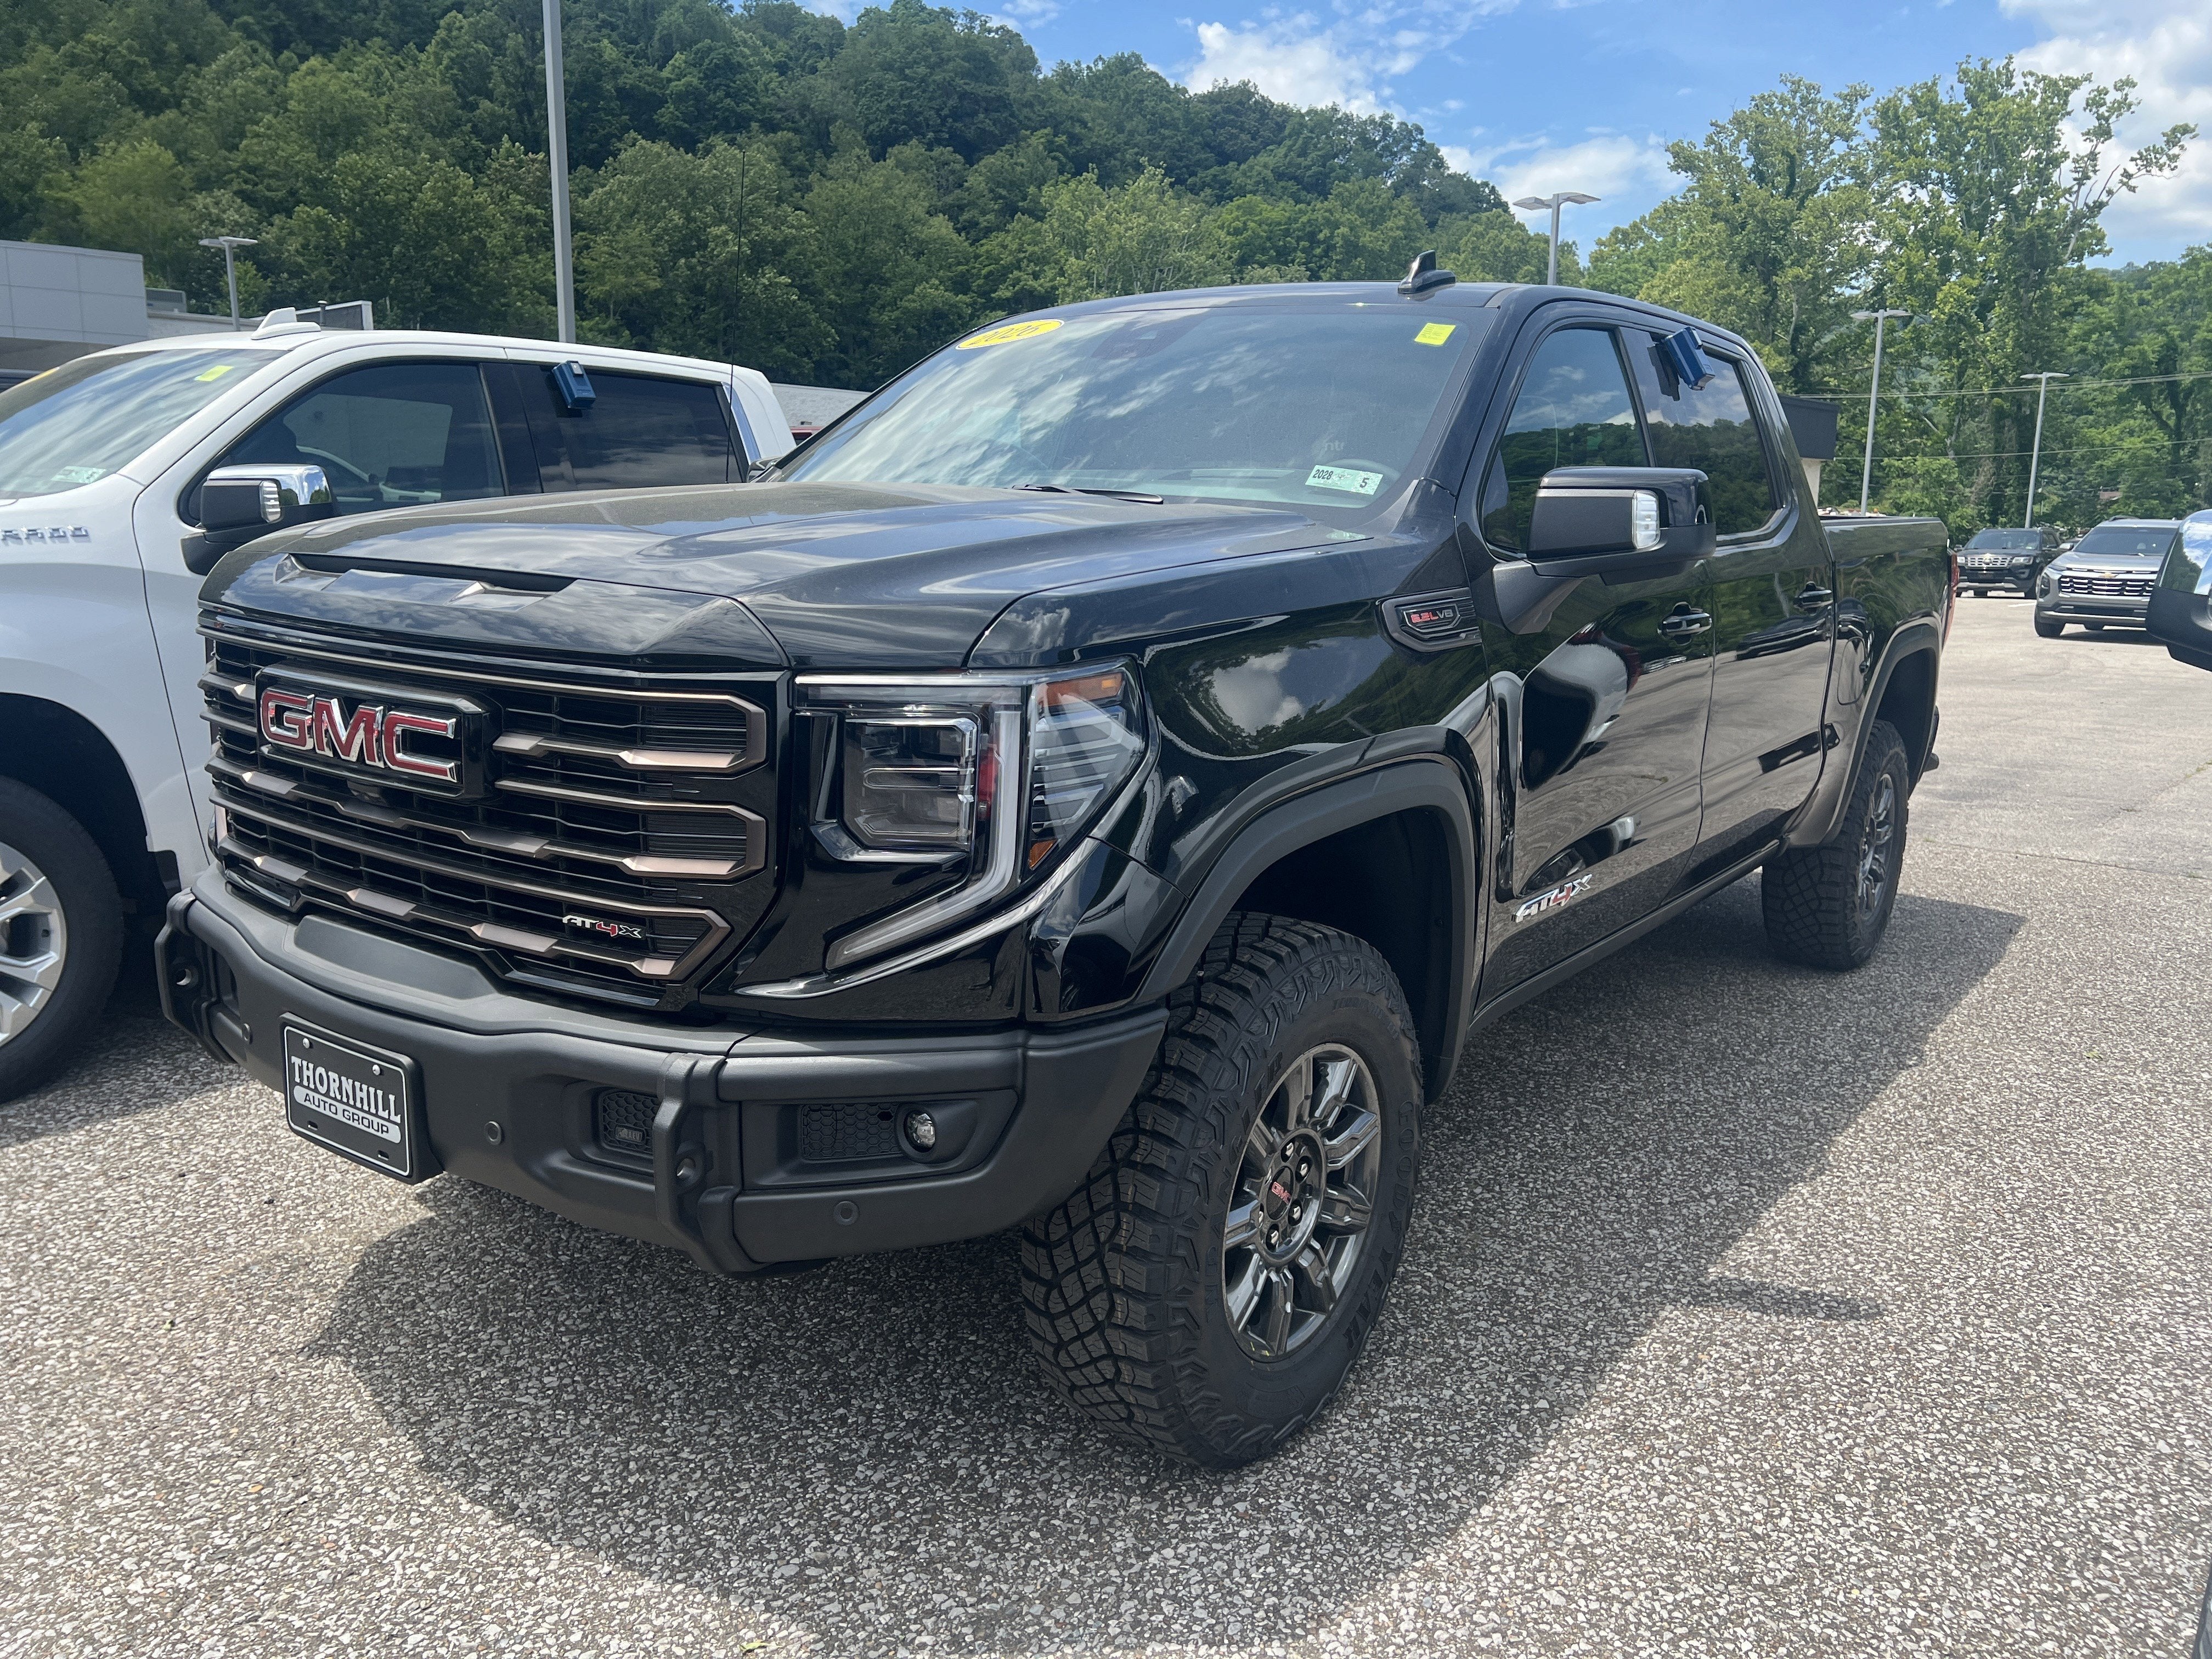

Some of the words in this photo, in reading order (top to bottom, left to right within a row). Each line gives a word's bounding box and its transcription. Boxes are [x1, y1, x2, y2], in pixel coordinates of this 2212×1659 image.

[1312, 469, 1334, 480] 2028
[1359, 477, 1370, 488] 5
[260, 689, 457, 782] GMC
[1515, 874, 1593, 923] AT4X
[562, 915, 642, 939] AT4X
[291, 1056, 402, 1124] THORNHILL
[304, 1093, 337, 1115] AUTO
[342, 1108, 389, 1134] GROUP
[1271, 1181, 1291, 1205] GMC
